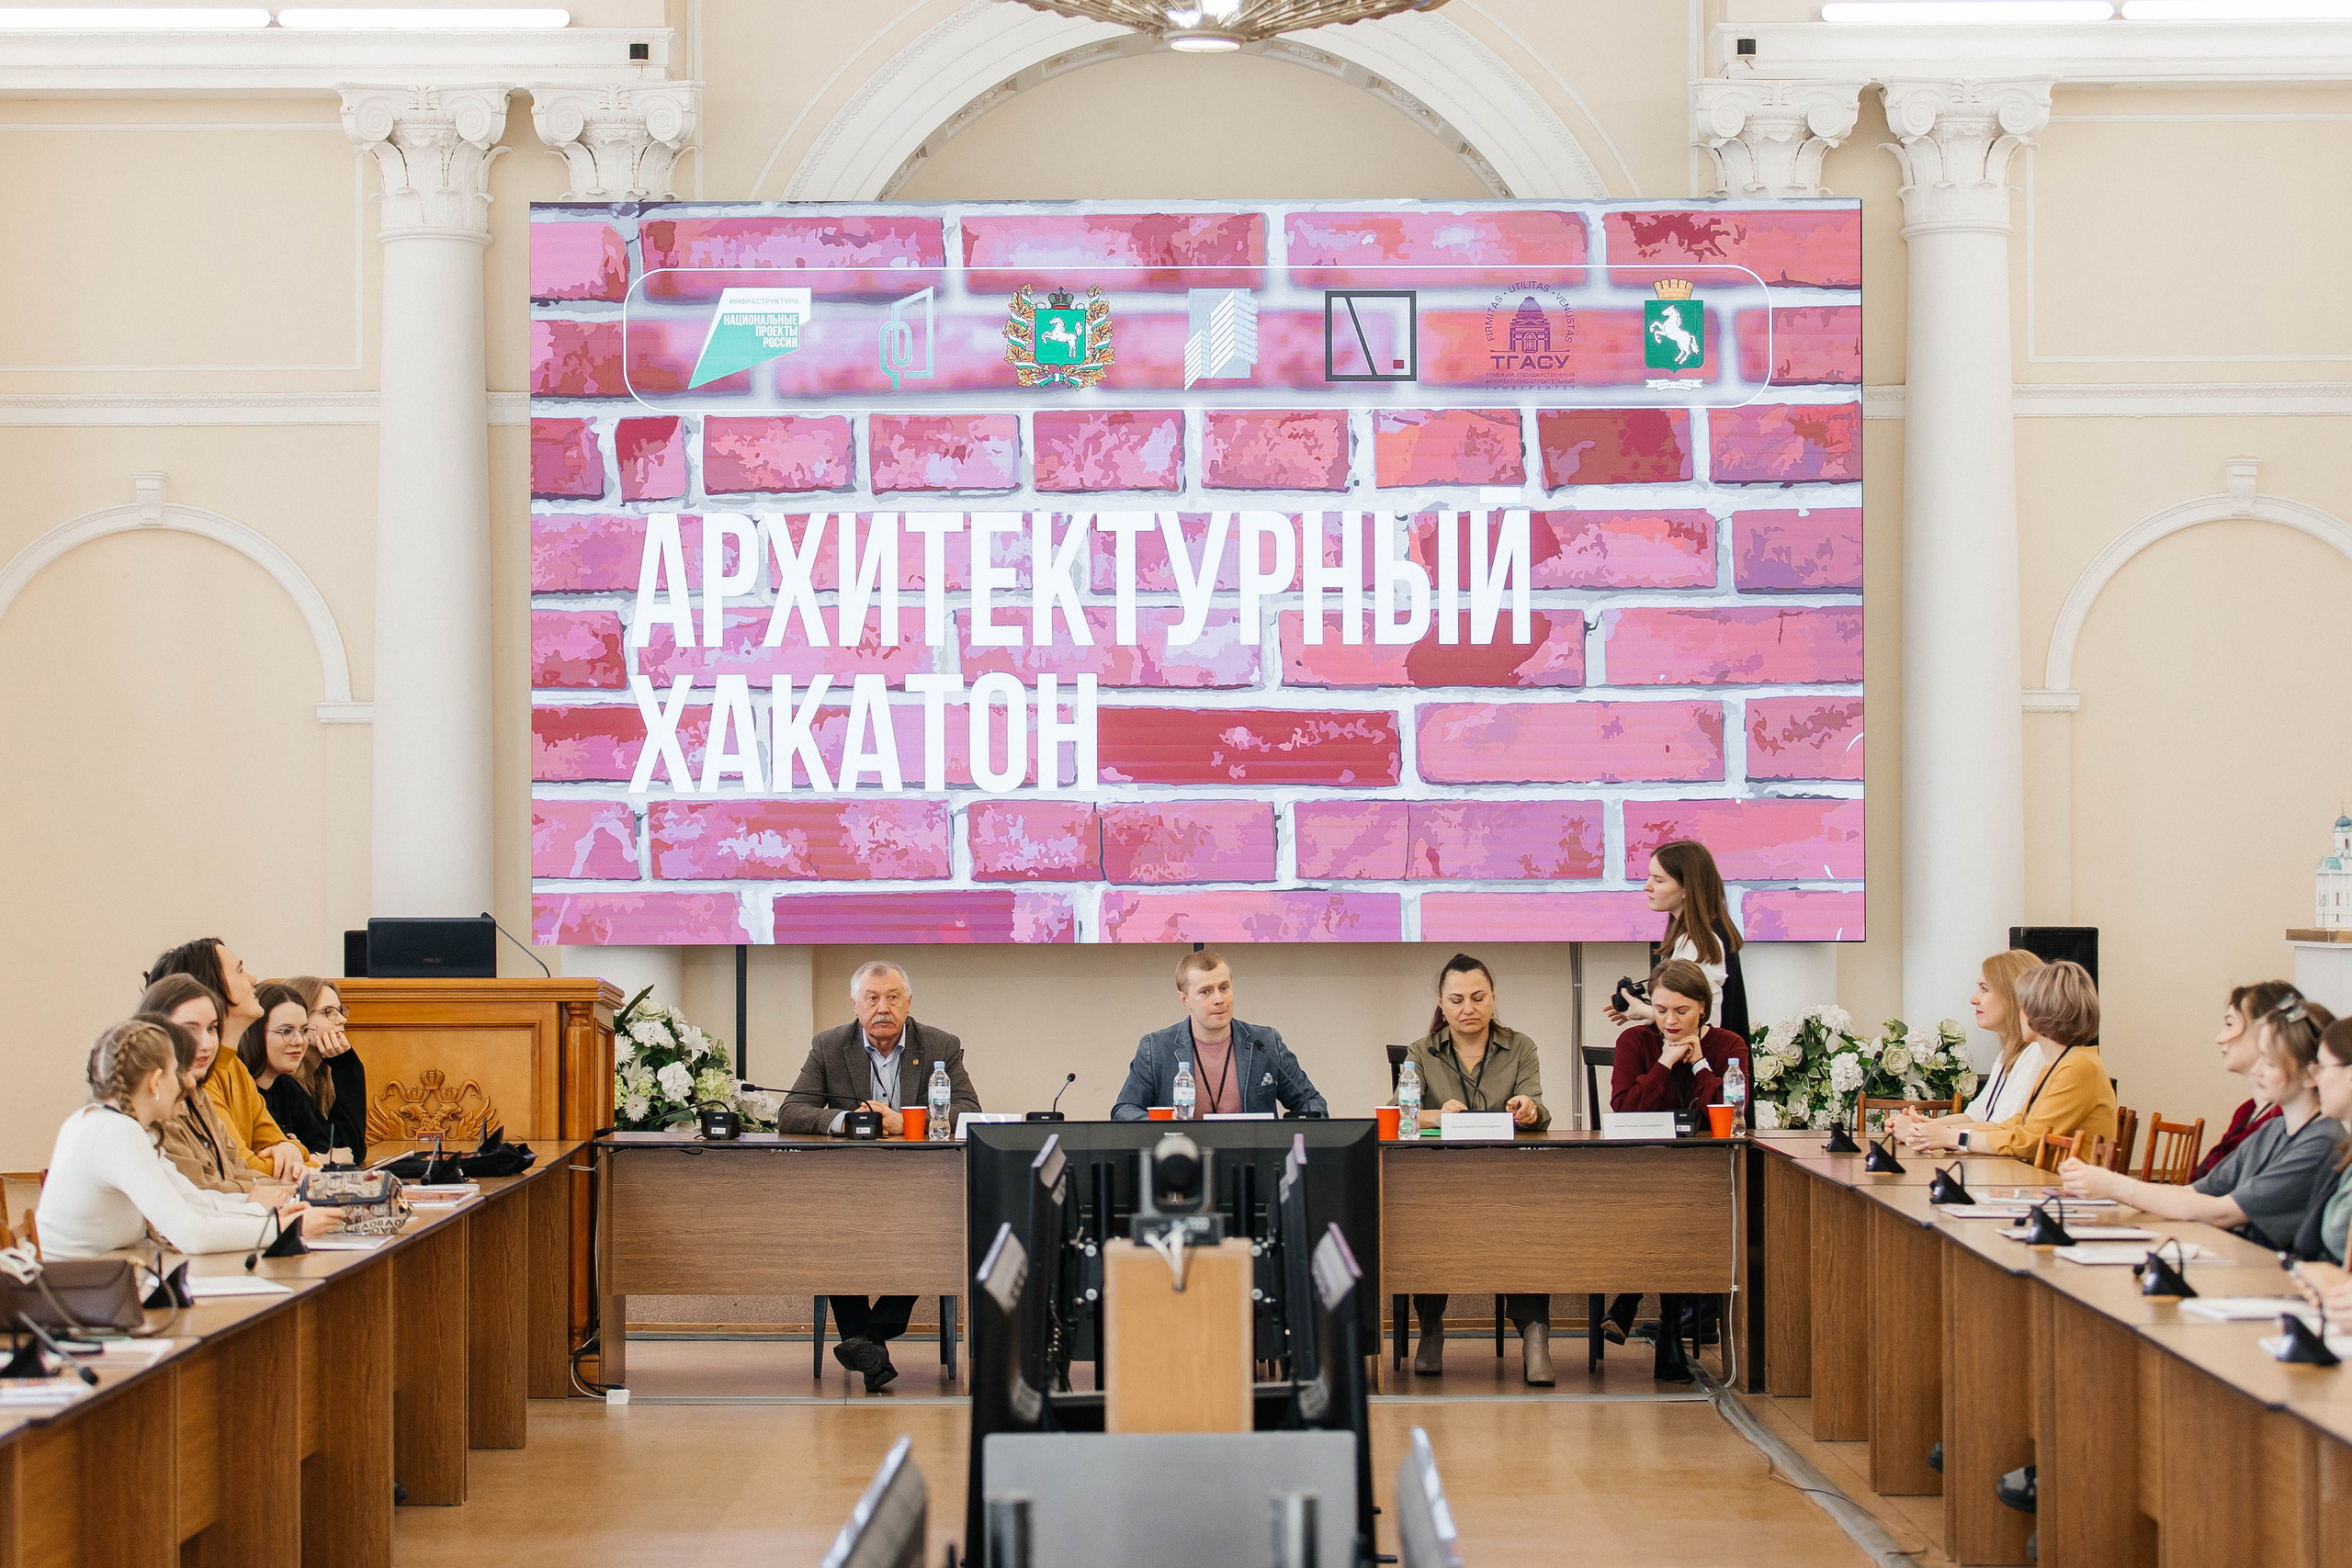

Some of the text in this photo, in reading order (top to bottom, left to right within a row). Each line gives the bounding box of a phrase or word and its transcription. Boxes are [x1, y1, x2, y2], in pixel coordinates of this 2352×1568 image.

[1507, 281, 1551, 293] UTILITAS
[723, 314, 798, 327] НАЦИОНАЛЬНЫЕ
[1485, 295, 1503, 342] FIRMITAS
[1555, 292, 1576, 344] VENUSTAS
[755, 325, 798, 337] ПРОЕКТЫ
[763, 336, 798, 348] РОССИИ
[1489, 355, 1570, 369] ТГАСУ
[630, 486, 1532, 648] АРХИТЕКТУРНЫЙ
[628, 671, 1098, 794] ХАКАТОН
